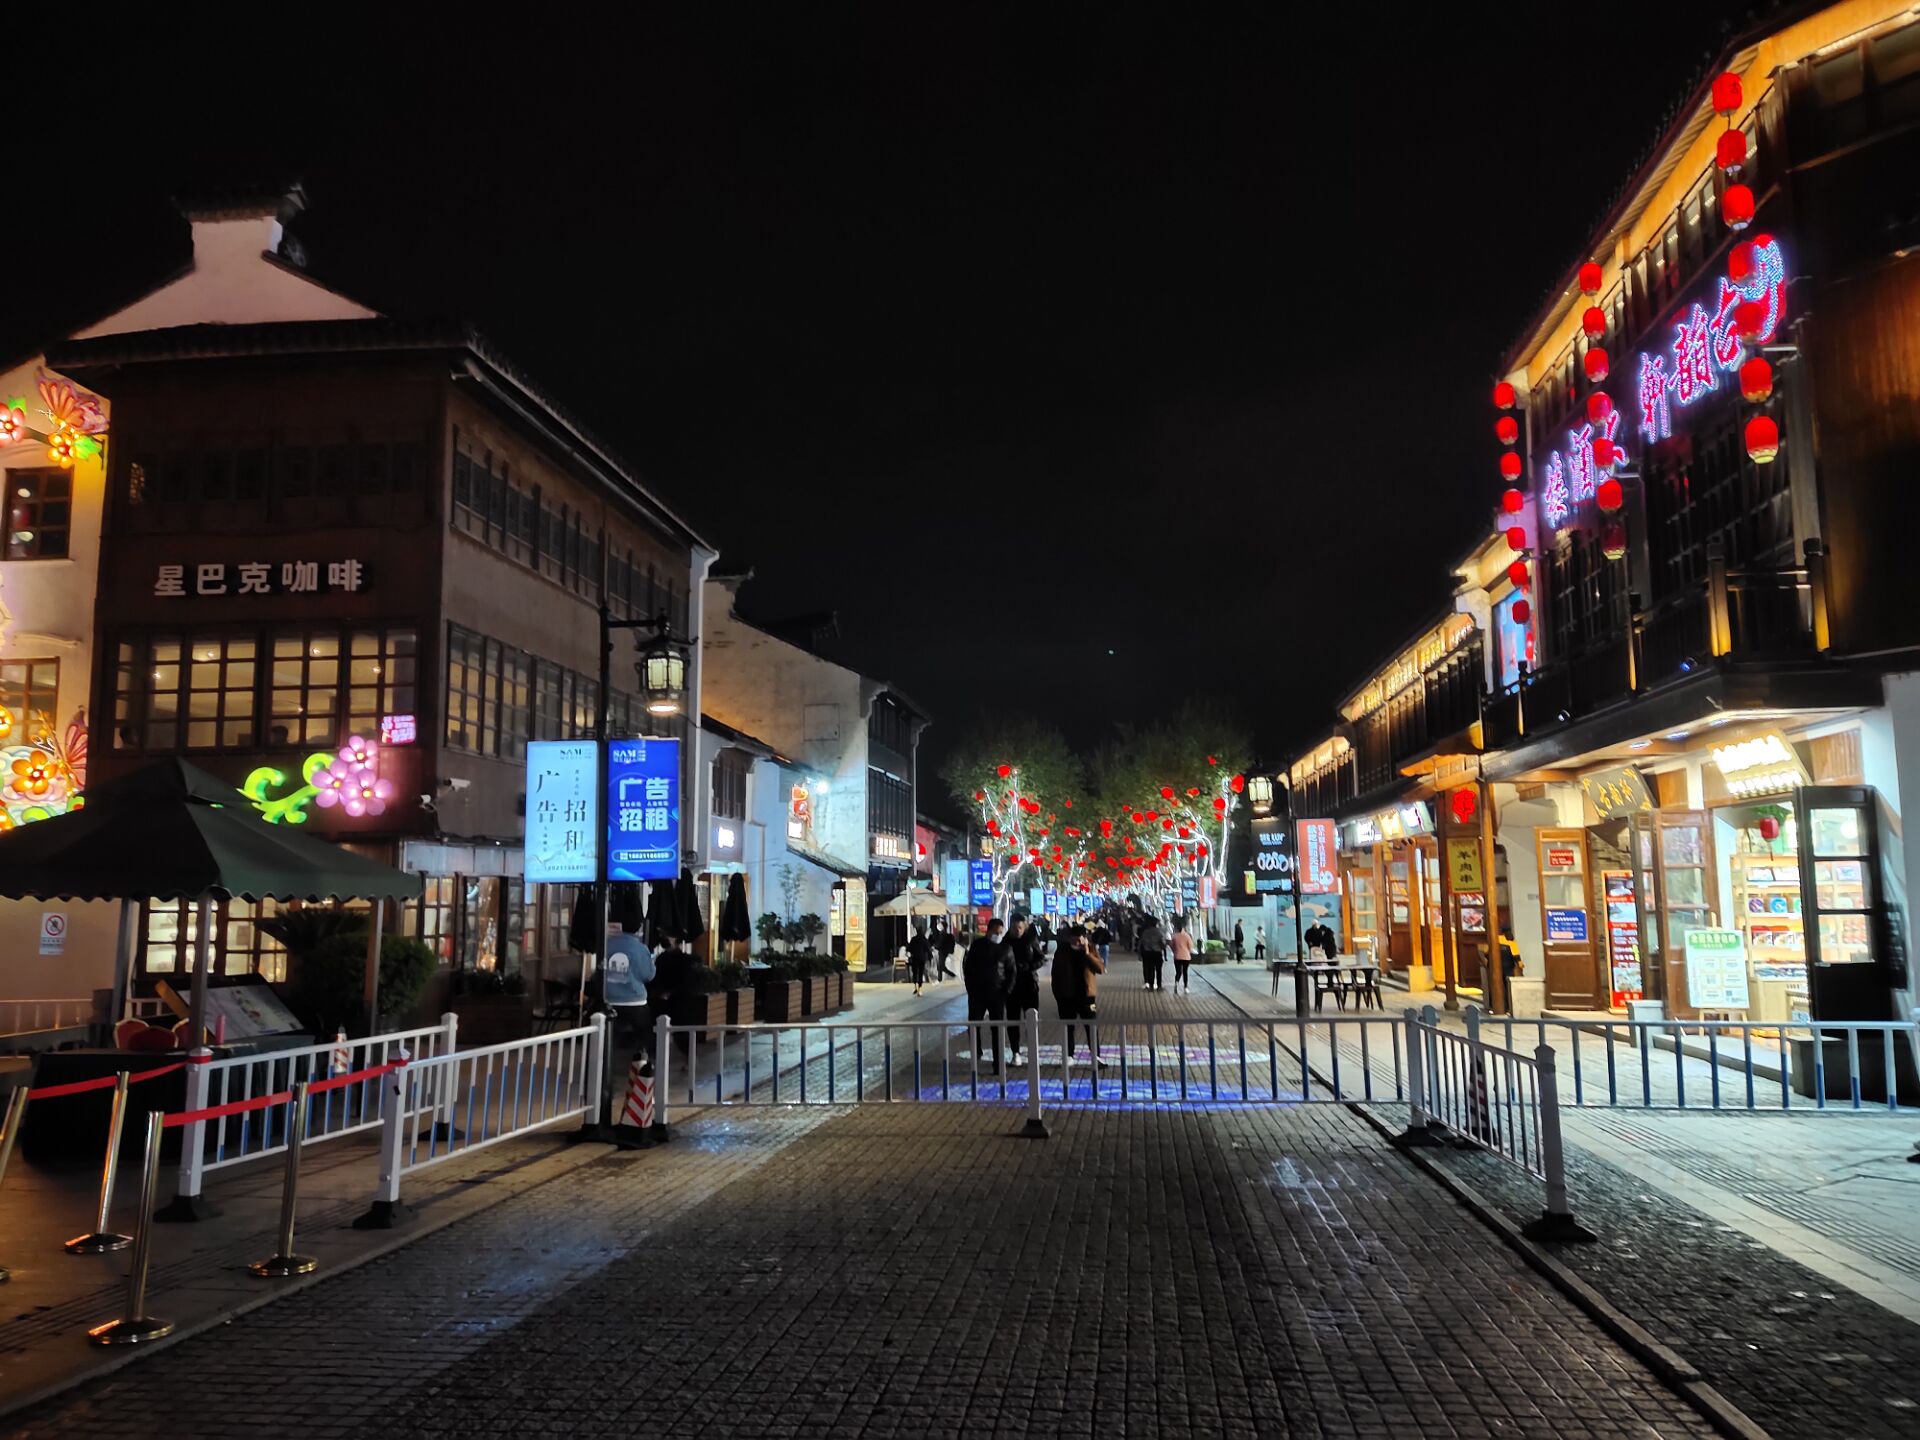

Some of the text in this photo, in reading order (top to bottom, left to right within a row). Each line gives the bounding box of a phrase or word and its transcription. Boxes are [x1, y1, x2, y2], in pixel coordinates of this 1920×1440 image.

[154, 559, 366, 598] 星巴克咖啡
[619, 777, 669, 801] 广告
[619, 808, 669, 832] 招租
